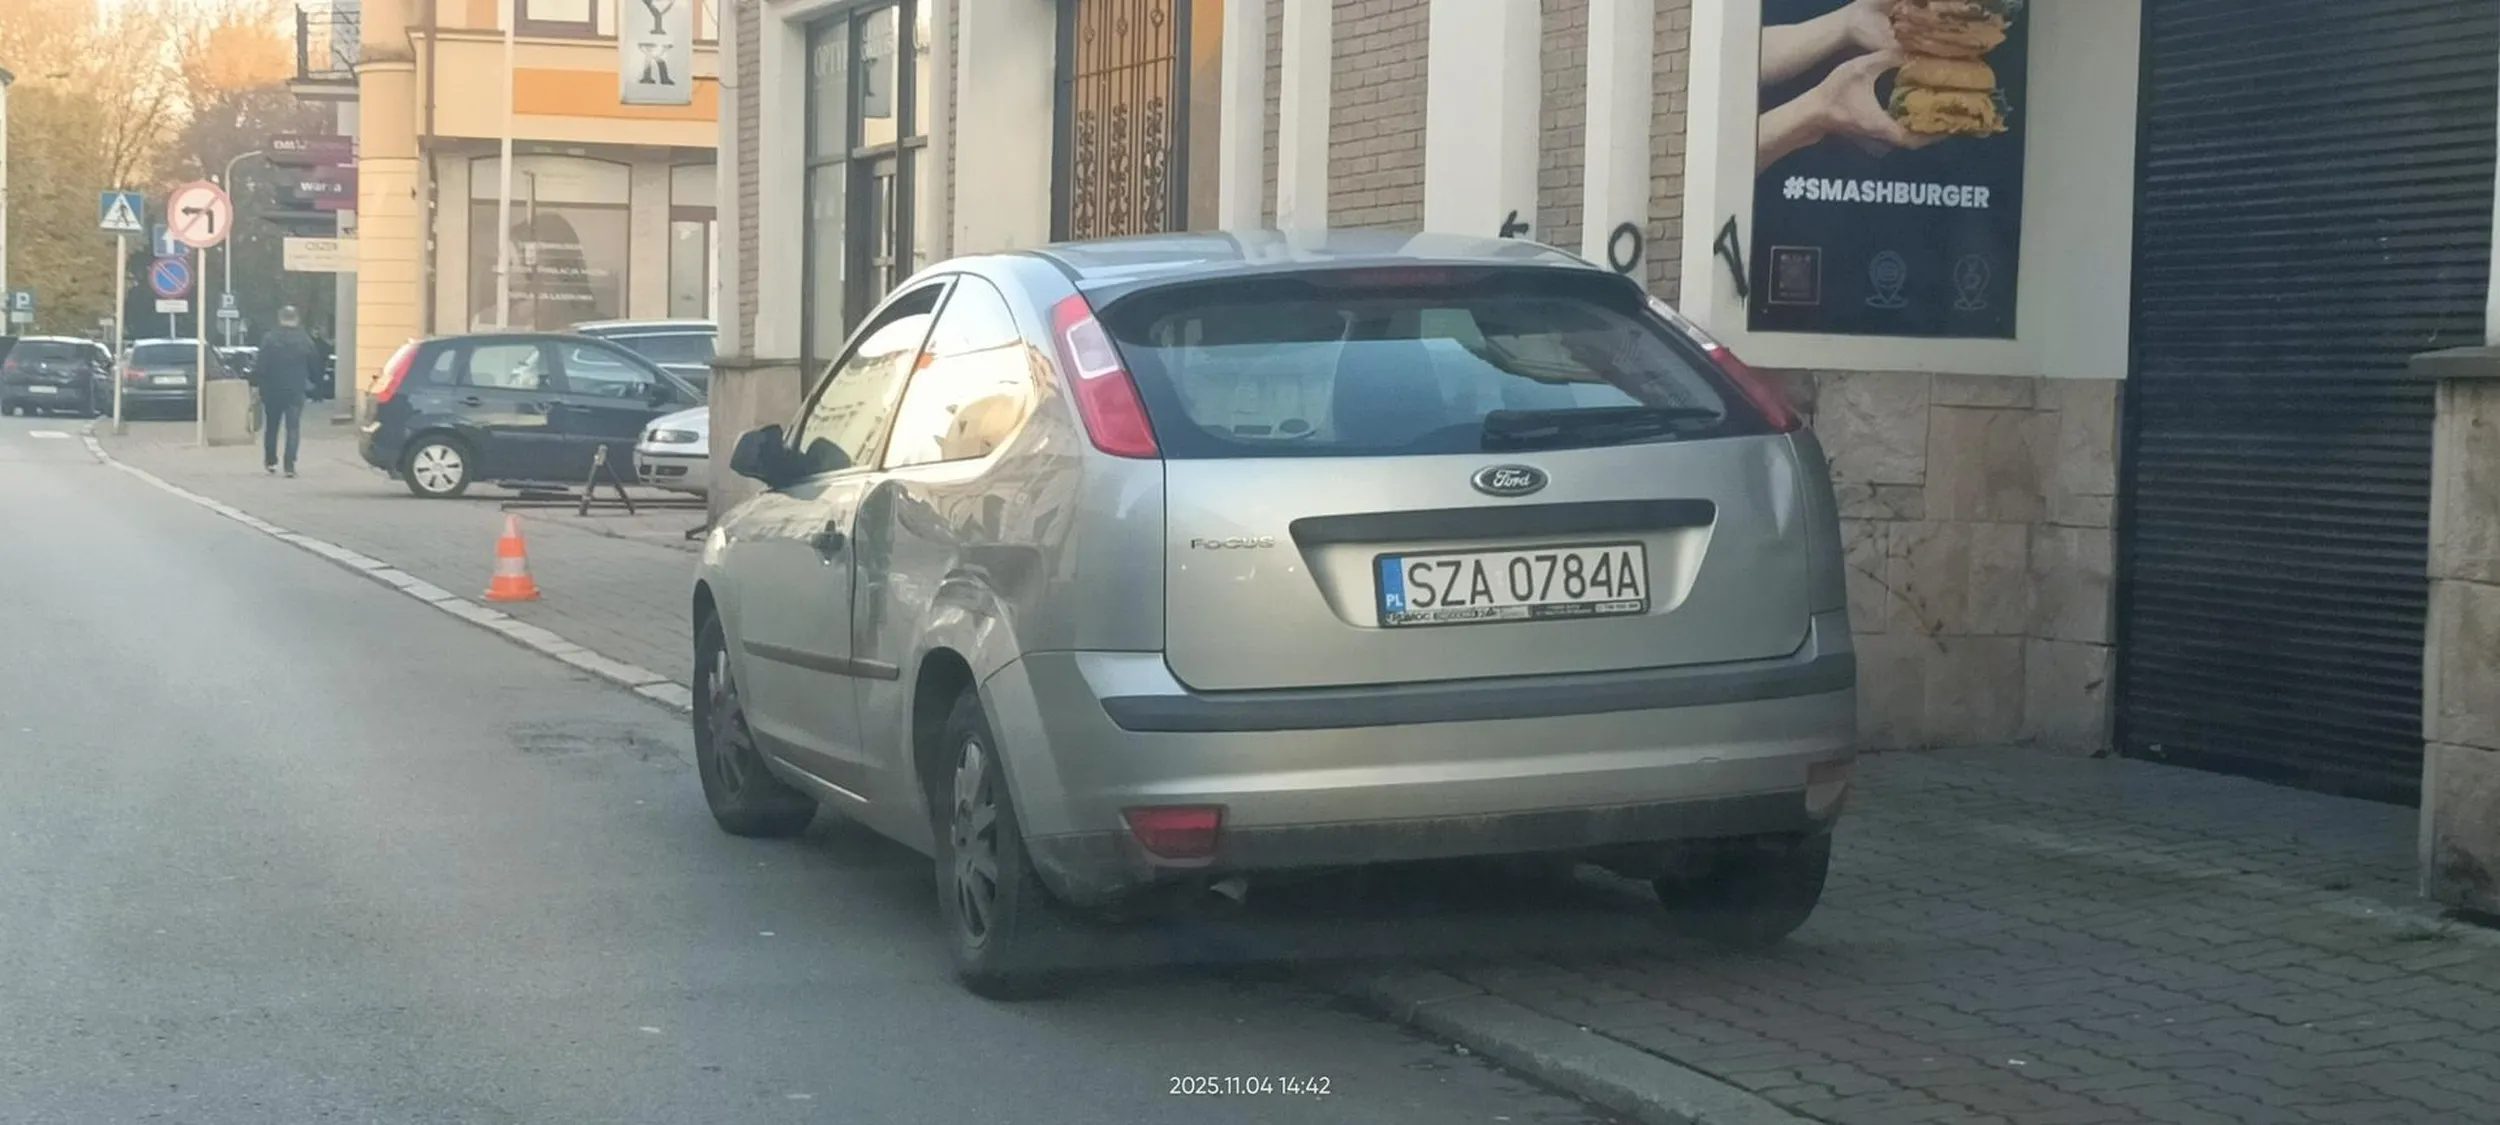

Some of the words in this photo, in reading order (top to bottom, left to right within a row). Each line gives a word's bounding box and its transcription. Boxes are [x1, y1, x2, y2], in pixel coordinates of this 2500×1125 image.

[301, 182, 342, 192] wara
[1783, 176, 1990, 208] #SMASHBURGER
[1493, 470, 1530, 487] Ford
[1191, 537, 1275, 550] FOCUS
[1408, 559, 1494, 608] SZA
[1509, 551, 1640, 601] 0784A
[1386, 593, 1404, 608] PL
